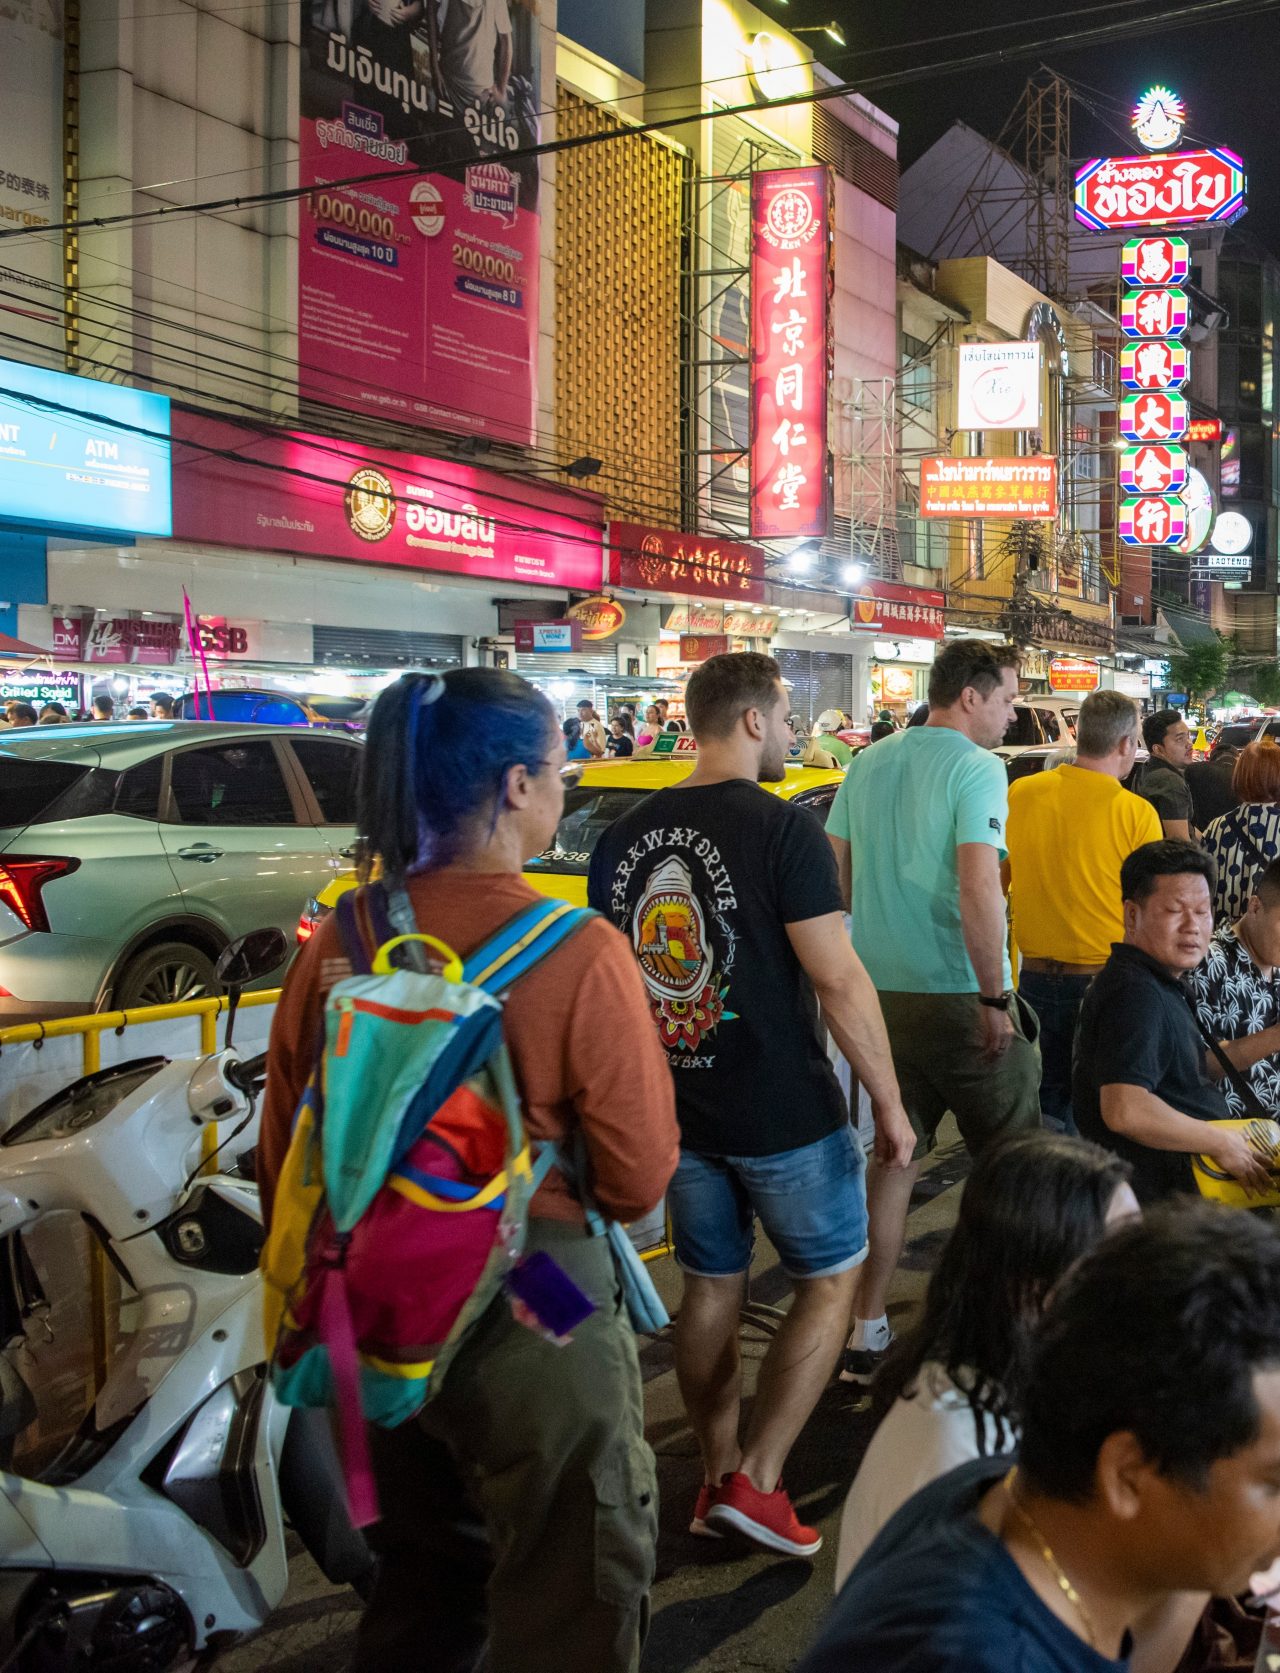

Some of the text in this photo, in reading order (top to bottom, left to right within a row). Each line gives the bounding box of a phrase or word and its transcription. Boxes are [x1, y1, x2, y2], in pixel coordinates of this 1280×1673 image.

[327, 31, 428, 114] มีเงินทุน
[464, 99, 519, 151] อุ่นใจ
[347, 112, 378, 133] สินเชื่อ
[1097, 163, 1164, 184] ห้างทอง
[1093, 161, 1227, 218] ทองใบ
[371, 244, 384, 260] 10
[452, 243, 514, 284] 200,000
[771, 256, 808, 511] 北京同仁堂
[85, 438, 118, 460] ATM
[406, 503, 495, 543] ออมสิน
[194, 624, 248, 653] GSB
[0, 686, 39, 698] Grilled
[676, 737, 697, 751] TA
[611, 827, 738, 914] PARKWAY DRIVE
